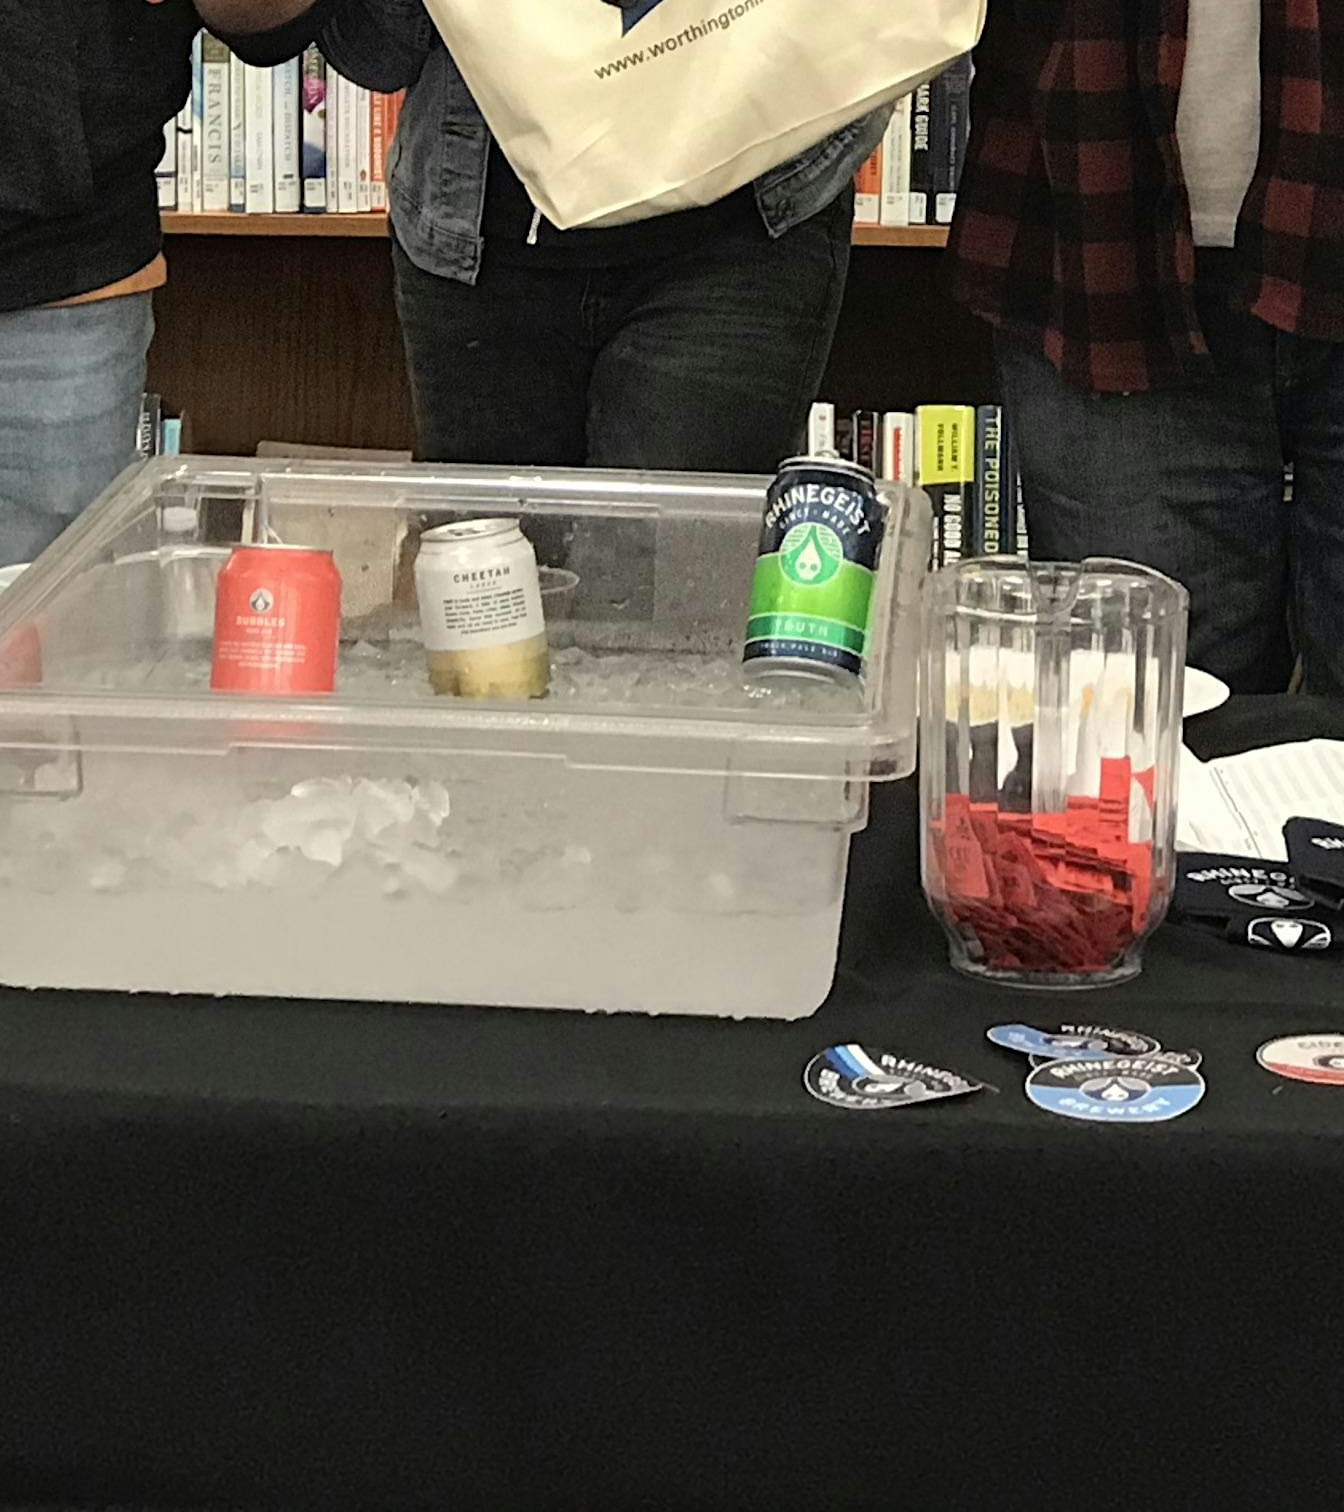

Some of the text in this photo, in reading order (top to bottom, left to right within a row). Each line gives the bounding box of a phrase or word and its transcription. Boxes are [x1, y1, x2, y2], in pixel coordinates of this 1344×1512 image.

[207, 68, 223, 165] FRANCIS
[764, 483, 872, 536] RHINEGEIST
[984, 415, 999, 553] THE POISONED
[944, 494, 962, 548] NO GOOD
[453, 566, 511, 584] CHEETAH
[1050, 1057, 1181, 1080] RHINEGEIST
[1058, 1097, 1171, 1116] BREWERY
